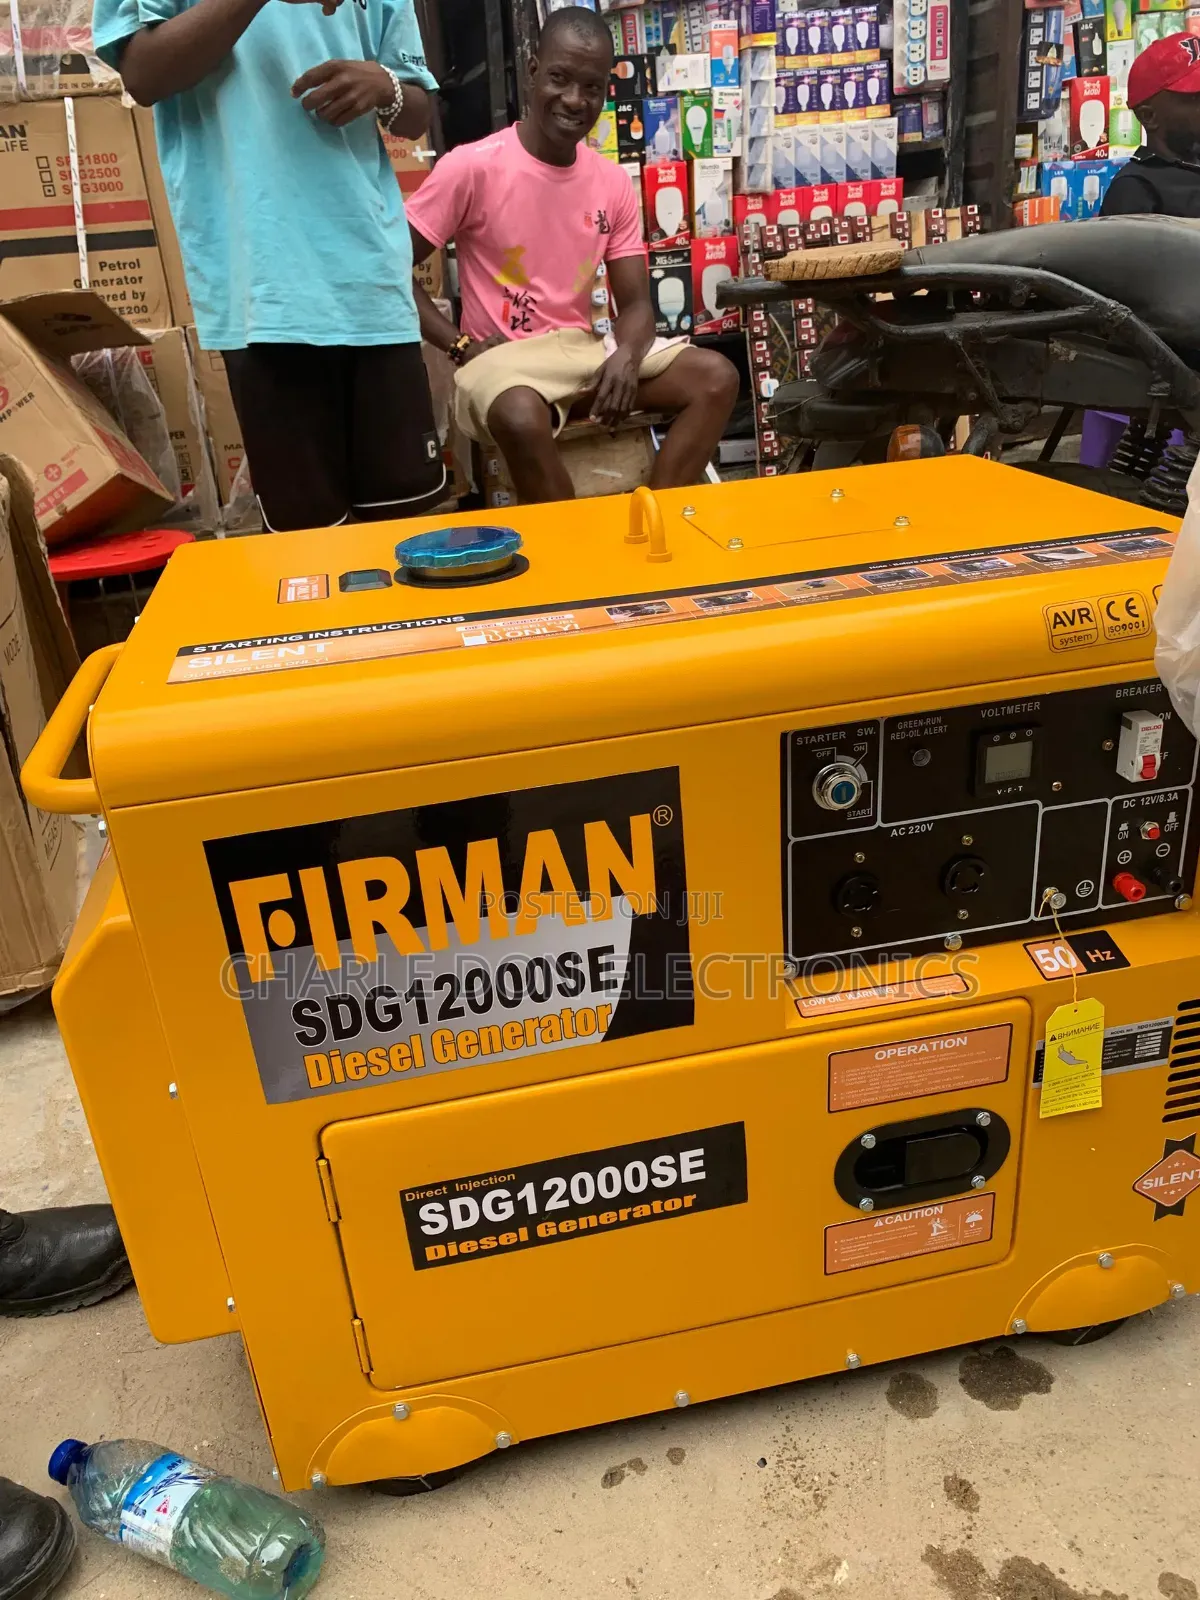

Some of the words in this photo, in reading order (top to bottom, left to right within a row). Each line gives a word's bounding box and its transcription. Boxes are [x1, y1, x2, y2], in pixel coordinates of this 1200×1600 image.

[617, 104, 632, 112] J&C
[59, 167, 121, 181] SG2500
[62, 181, 124, 194] SG3000
[99, 259, 141, 271] Petrol
[73, 275, 143, 289] Gnerator
[132, 290, 146, 302] by
[1053, 607, 1094, 629] AVR
[192, 634, 304, 654] STARTING
[308, 615, 466, 640] INSTRUCTIONS
[505, 622, 581, 639] ONLY!
[1108, 620, 1145, 634] ISO9001
[1060, 632, 1092, 648] system
[187, 641, 334, 669] SILENT
[183, 666, 251, 680] OUTDOOR
[254, 662, 282, 671] USE
[1115, 683, 1163, 698] BREAKER
[980, 701, 1041, 718] VOLTMETER
[1158, 712, 1172, 721] ON
[897, 716, 943, 730] GREEN-RUN
[796, 731, 847, 746] STARTER
[857, 726, 877, 737] SW.
[890, 731, 921, 741] RED-OIL
[923, 725, 948, 736] ALERT
[816, 750, 832, 758] OFF
[1123, 797, 1136, 809] DC
[1140, 792, 1179, 807] 12V/8.3A
[847, 808, 871, 818] START
[890, 828, 906, 837] AC
[908, 822, 934, 835] 220V
[1118, 830, 1129, 840] ON
[1164, 822, 1179, 832] OFF
[228, 813, 658, 984] FIRMAN
[1034, 945, 1078, 972] 50
[1086, 948, 1115, 963] Hz
[290, 944, 619, 1048] SDG12000SE
[802, 997, 826, 1008] LOW
[827, 994, 844, 1004] OIL
[1057, 1022, 1100, 1040] ВНИМАНИЕ
[304, 1031, 427, 1089] Diesel
[430, 1003, 613, 1065] Generator
[874, 1036, 968, 1061] OPERATION
[405, 1185, 448, 1202] Direct
[455, 1173, 516, 1191] Injection
[1142, 1169, 1200, 1190] SILENT
[418, 1148, 706, 1236] SDG12000SE
[885, 1205, 944, 1226] CAUTION
[424, 1226, 529, 1262] Diesel
[536, 1193, 697, 1239] Generator
